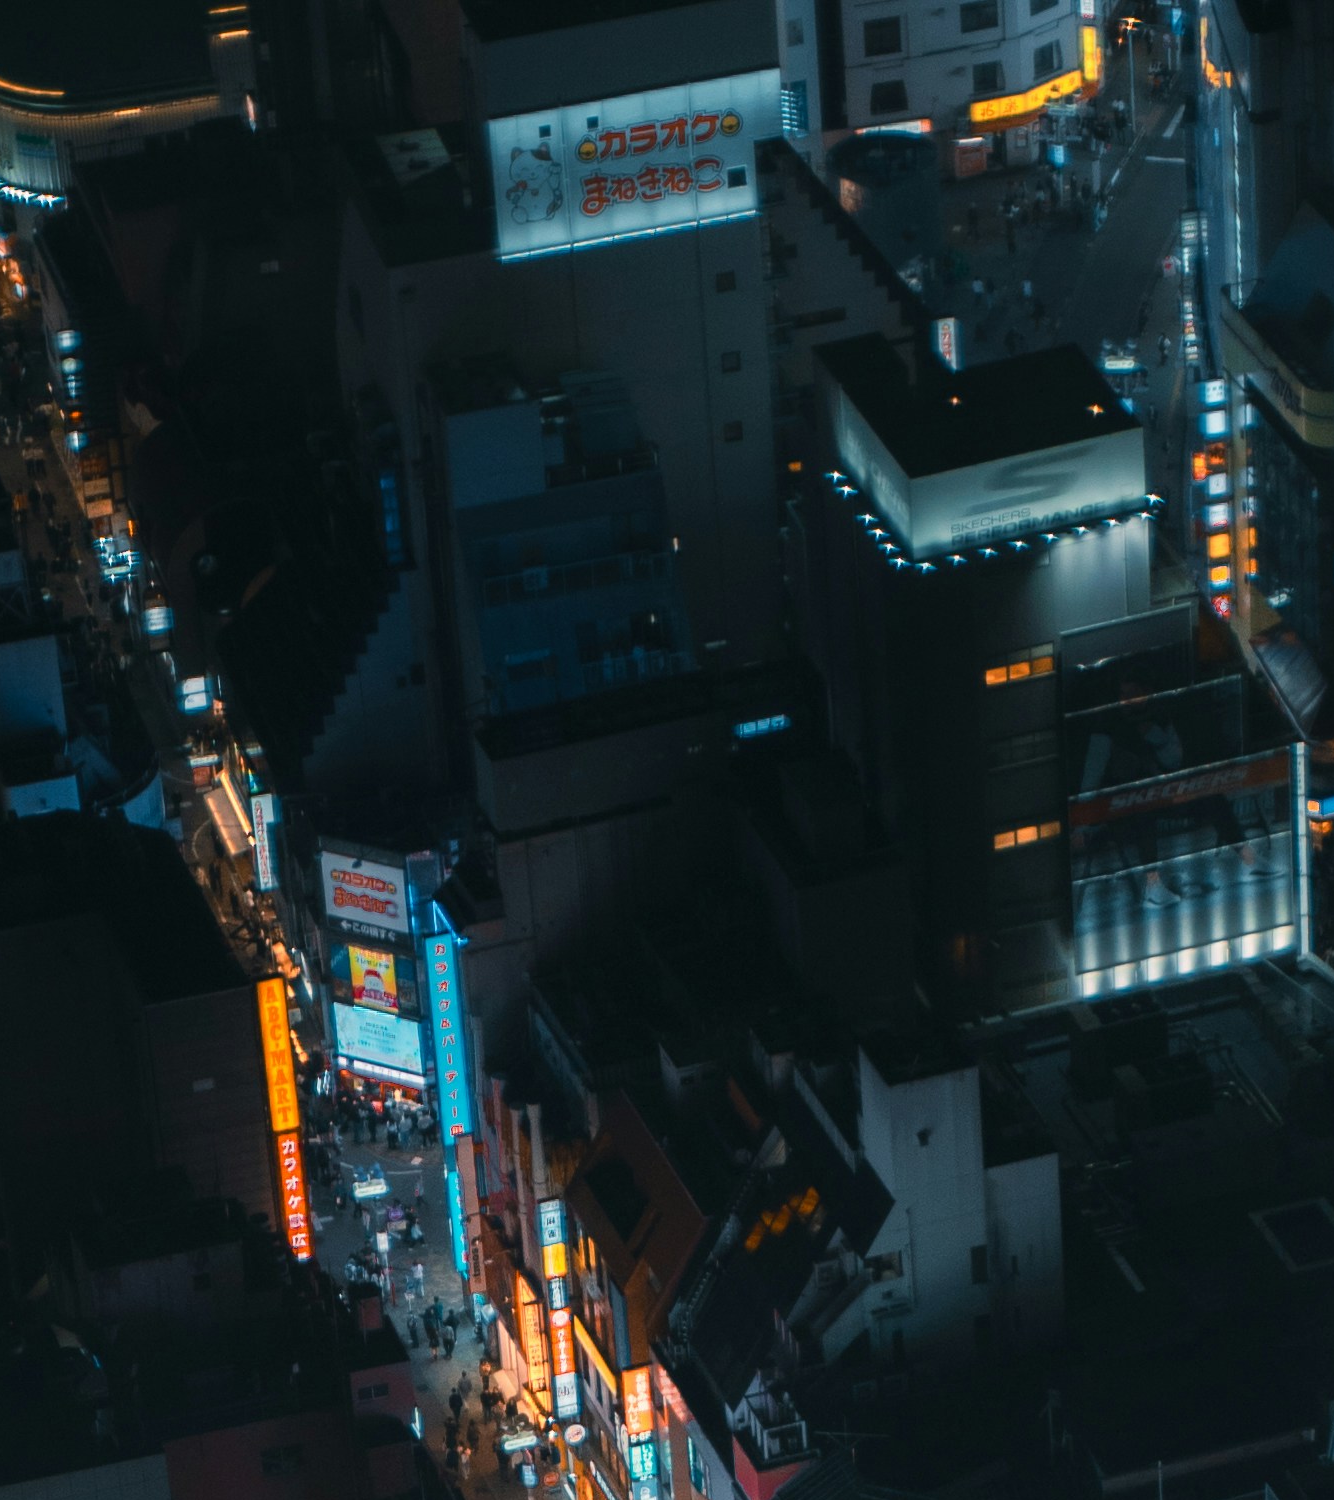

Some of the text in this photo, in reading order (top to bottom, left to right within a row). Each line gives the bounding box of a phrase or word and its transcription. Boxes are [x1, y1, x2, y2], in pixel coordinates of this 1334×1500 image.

[597, 114, 717, 160] カラオケ
[581, 156, 725, 217] まねきねこ
[950, 506, 1031, 535] SKECHERS
[951, 502, 1108, 546] PERFORMANCE
[1108, 765, 1249, 809] SKECHERS
